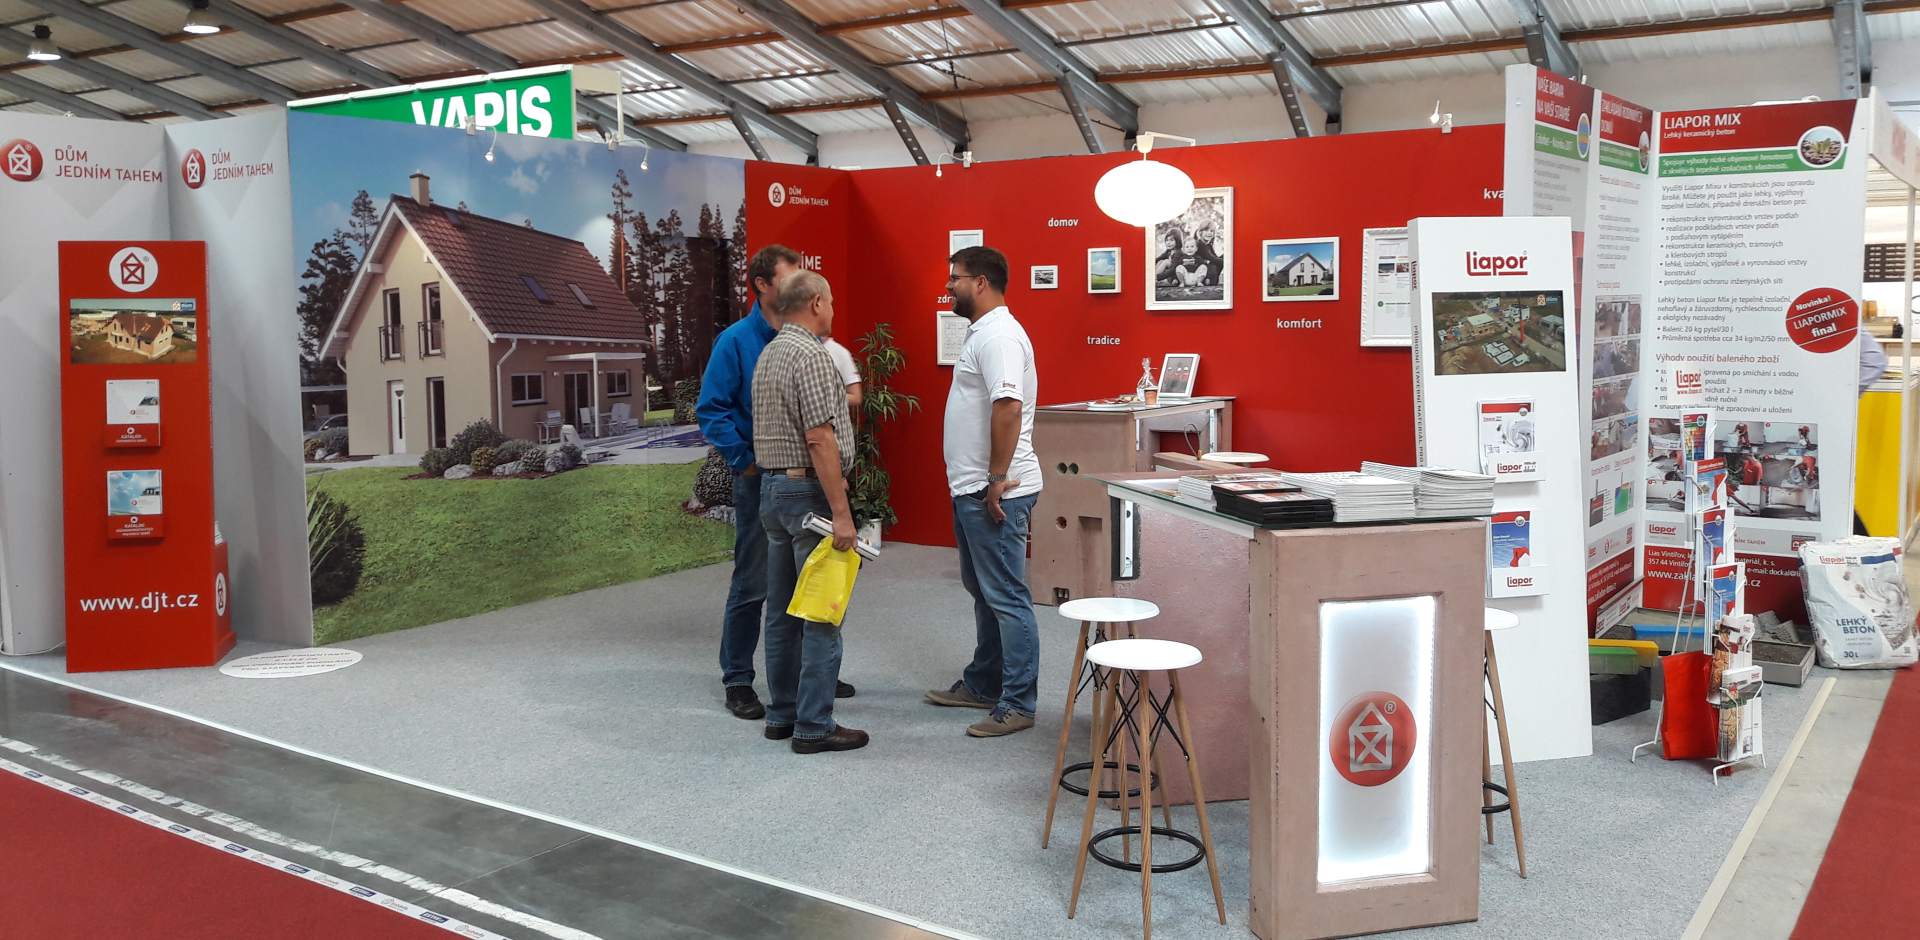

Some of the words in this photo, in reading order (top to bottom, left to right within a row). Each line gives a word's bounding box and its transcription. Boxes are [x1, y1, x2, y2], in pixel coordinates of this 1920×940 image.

[1664, 115, 1711, 130] LIAPOR
[1715, 113, 1742, 127] MIX
[55, 145, 88, 162] DŮM
[212, 148, 231, 165] DŮM
[55, 163, 111, 180] JEDNÍM
[115, 168, 163, 183] TAHEM
[212, 165, 245, 181] JEDNÍM
[248, 162, 274, 177] TAHEM
[1484, 188, 1504, 200] kva
[811, 197, 829, 206] TAHEM
[1048, 217, 1079, 228] domov
[800, 250, 822, 270] ÍME
[1466, 250, 1528, 276] Liapor
[937, 294, 953, 304] zdr
[1796, 295, 1832, 311] Novinka!
[1276, 318, 1322, 329] komfort
[1793, 307, 1848, 330] LIAPORMIX
[1811, 323, 1837, 337] final
[1087, 335, 1121, 346] tradice
[1717, 354, 1755, 363] baleného
[1757, 354, 1780, 363] zboží
[1497, 463, 1522, 474] Liapor
[1669, 560, 1691, 568] Vintířo
[1648, 570, 1696, 581] www.zakla
[1507, 576, 1533, 588] Liapor
[80, 591, 199, 613] www.djt.cz
[1836, 615, 1867, 626] LEHKÝ
[1843, 626, 1876, 634] BETON
